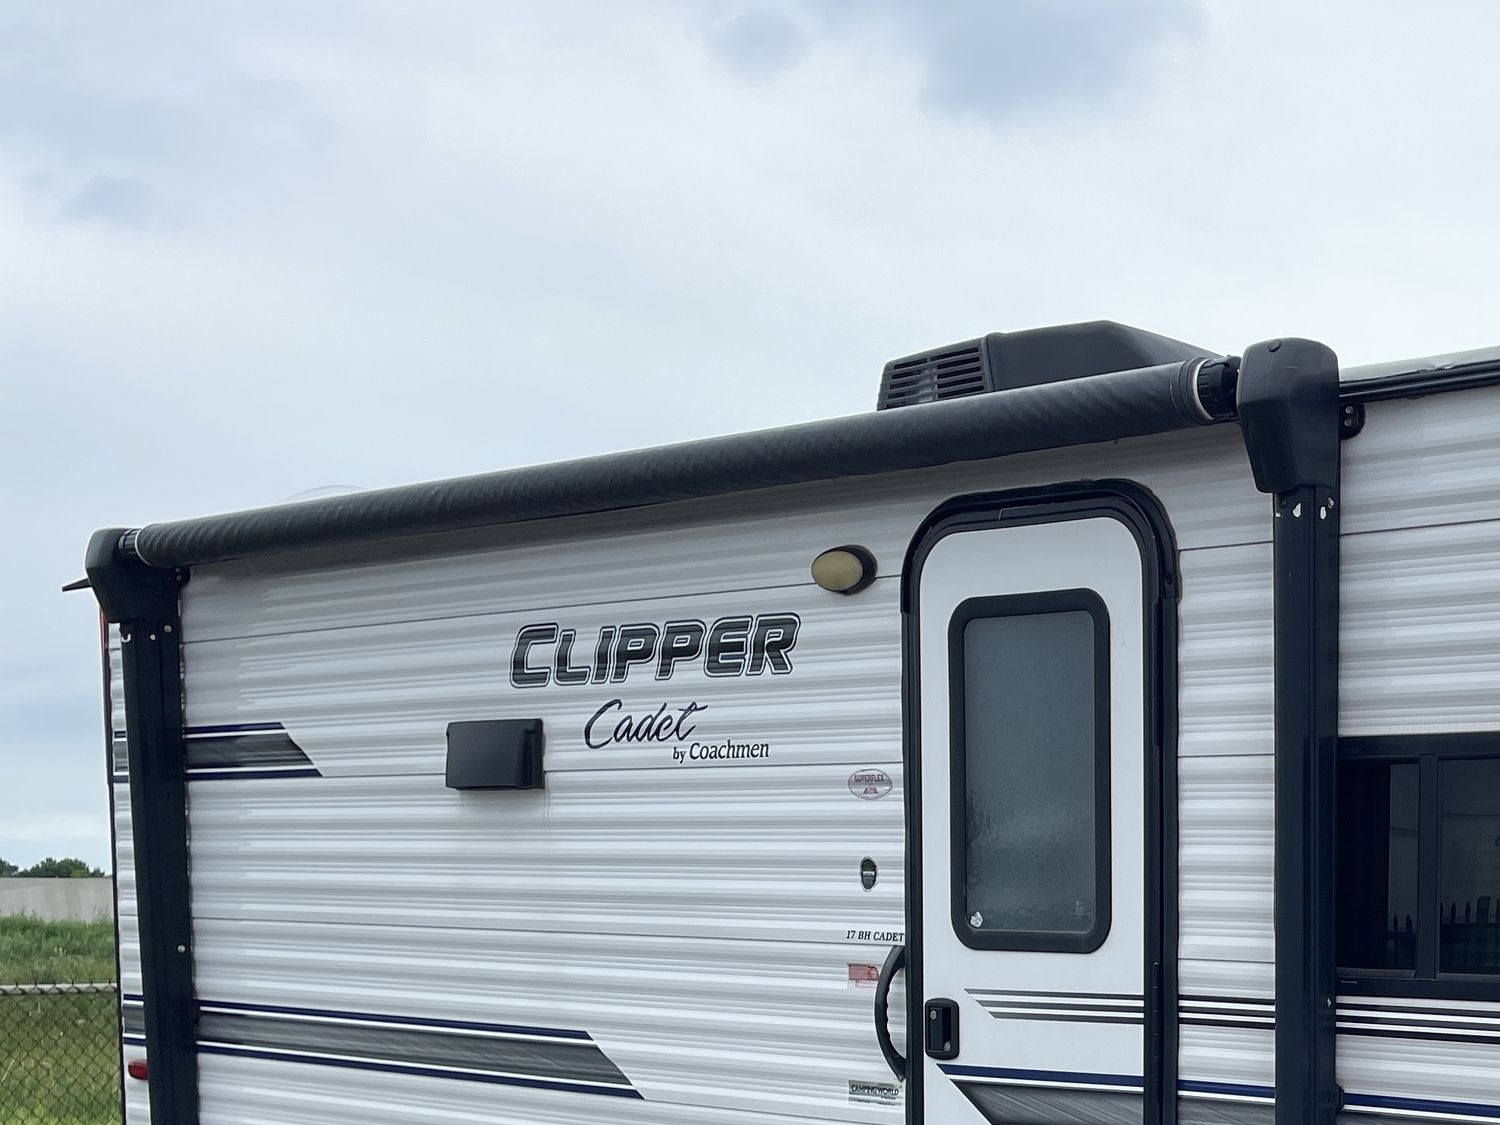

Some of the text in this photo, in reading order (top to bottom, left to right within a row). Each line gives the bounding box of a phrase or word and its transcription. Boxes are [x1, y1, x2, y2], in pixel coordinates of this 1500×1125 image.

[510, 612, 800, 688] CLIPPER
[584, 699, 708, 749] Cadet
[673, 739, 769, 764] by Coachmen
[846, 930, 904, 942] 17 BH CADET
